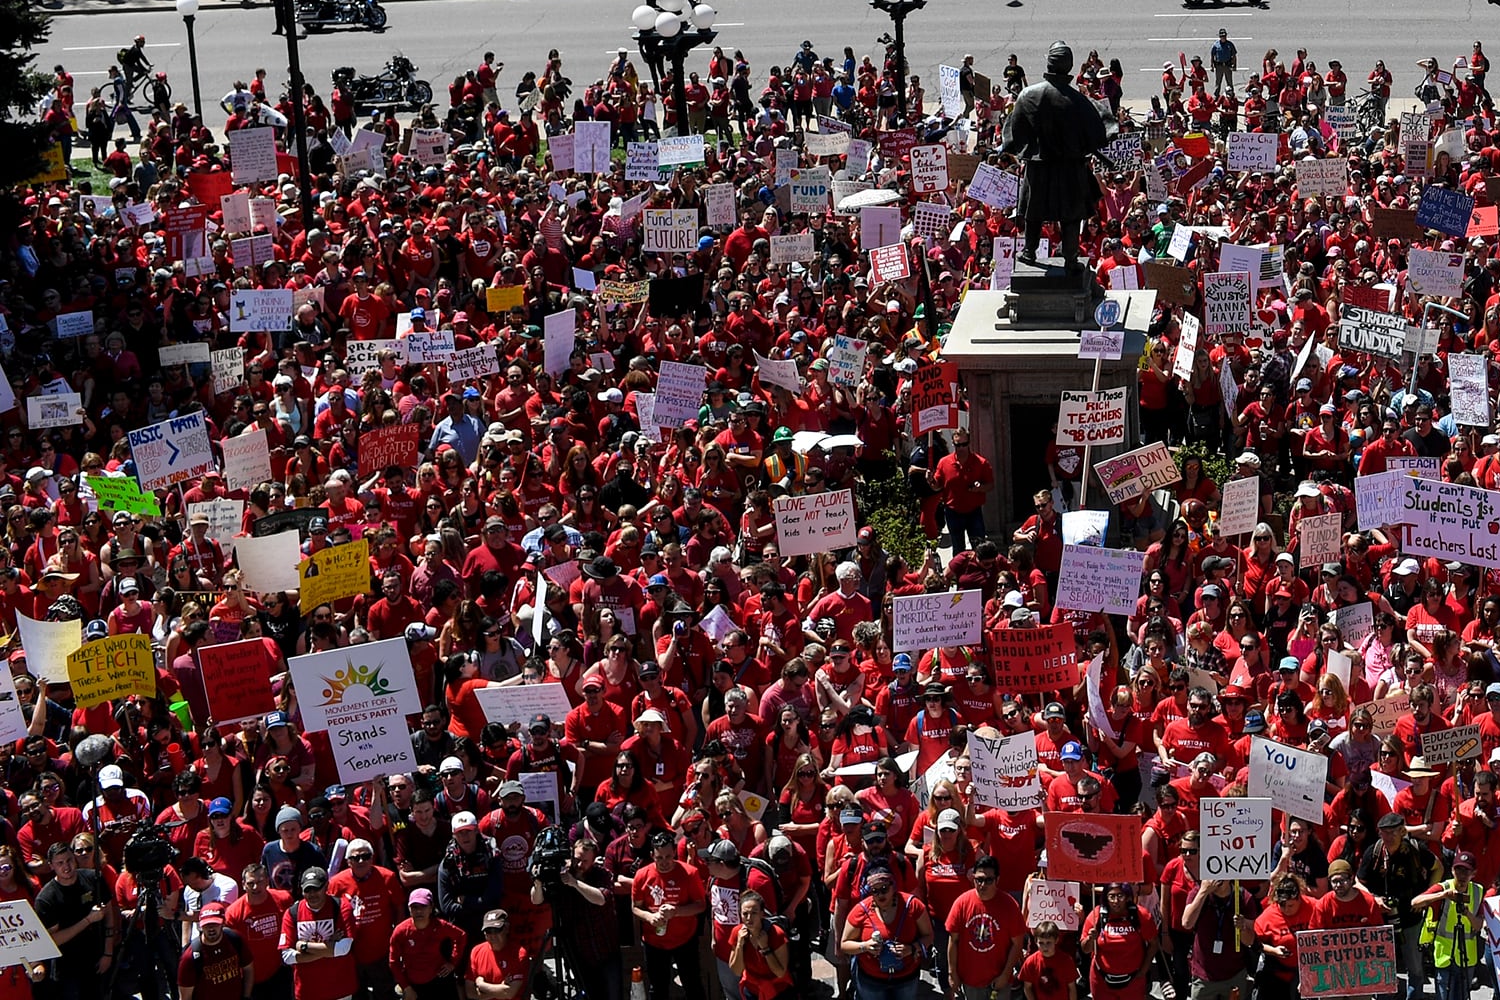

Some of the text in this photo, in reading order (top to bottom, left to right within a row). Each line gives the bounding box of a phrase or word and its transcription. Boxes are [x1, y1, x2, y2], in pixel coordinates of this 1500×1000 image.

[940, 66, 959, 79] STOP
[1229, 153, 1268, 162] School
[1302, 171, 1340, 180] PROBLEMS
[792, 185, 827, 197] FUND
[1423, 186, 1474, 211] ARM WITH
[646, 210, 673, 227] Fund
[646, 229, 698, 250] FUTURE!
[1416, 267, 1454, 279] EDUCATION
[1208, 303, 1247, 313] WANNA
[1211, 313, 1245, 322] HAVE
[1347, 307, 1407, 329] STRAIGHT
[1206, 322, 1250, 338] FUNDING
[347, 341, 377, 354] PRE
[835, 336, 849, 350] WE
[1340, 324, 1404, 355] FUNDING
[422, 350, 446, 361] Future
[450, 346, 486, 362] Budget
[460, 368, 471, 379] is
[661, 362, 706, 376] TEACHERS
[844, 370, 855, 380] US
[911, 366, 943, 382] FUND
[923, 380, 944, 391] OUR
[656, 395, 701, 410] IMPOSSIBLE
[1094, 391, 1123, 403] Those
[1085, 401, 1111, 412] RICH
[1067, 408, 1123, 426] TEACHERS
[129, 424, 163, 447] BASIC
[379, 424, 419, 438] BENEFITS
[142, 456, 162, 475] ED
[1387, 458, 1437, 470] I TEACH
[142, 475, 167, 492] REFORM
[1138, 465, 1181, 489] BILLS!
[1413, 479, 1489, 506] You can't put
[777, 491, 850, 513] LOVE ALONE
[1404, 490, 1473, 517] Students
[782, 509, 848, 524] does NOT teach
[1302, 514, 1339, 530] MORE
[1440, 517, 1481, 530] you put
[784, 527, 816, 538] kids to
[1310, 543, 1329, 554] FOR
[1399, 522, 1498, 561] Teachers Last
[1301, 551, 1341, 564] EDUCATION
[896, 596, 941, 613] DOLORES
[942, 611, 977, 623] taught us
[895, 624, 946, 637] that education
[994, 629, 1054, 642] TEACHING
[72, 640, 128, 663] THOSE WHO
[994, 641, 1064, 657] SHOULDN'T
[80, 651, 138, 674] TEACH
[995, 653, 1077, 672] BE A DEBT
[74, 670, 128, 689] THOSE WHO
[996, 669, 1071, 687] SENTENCE!
[324, 696, 396, 716] MOVEMENT FOR A
[327, 707, 399, 727] PEOPLE'S PARTY
[338, 724, 388, 747] Stands
[1422, 727, 1480, 745] EDUCATION
[1001, 745, 1033, 763] wish
[1424, 743, 1449, 754] CUTS
[343, 751, 408, 772] Teachers
[1264, 745, 1297, 770] YOU
[972, 760, 1040, 779] our politicians
[975, 776, 999, 789] were
[994, 789, 1041, 808] teachers
[1236, 808, 1251, 816] IN
[1207, 825, 1233, 837] IS
[1220, 835, 1257, 851] NOT
[1206, 852, 1270, 876] OKAY!
[1036, 884, 1066, 898] Fund
[1039, 900, 1061, 910] our
[1032, 909, 1075, 925] schools
[1297, 935, 1318, 948] OUR
[1300, 951, 1322, 966] OUR
